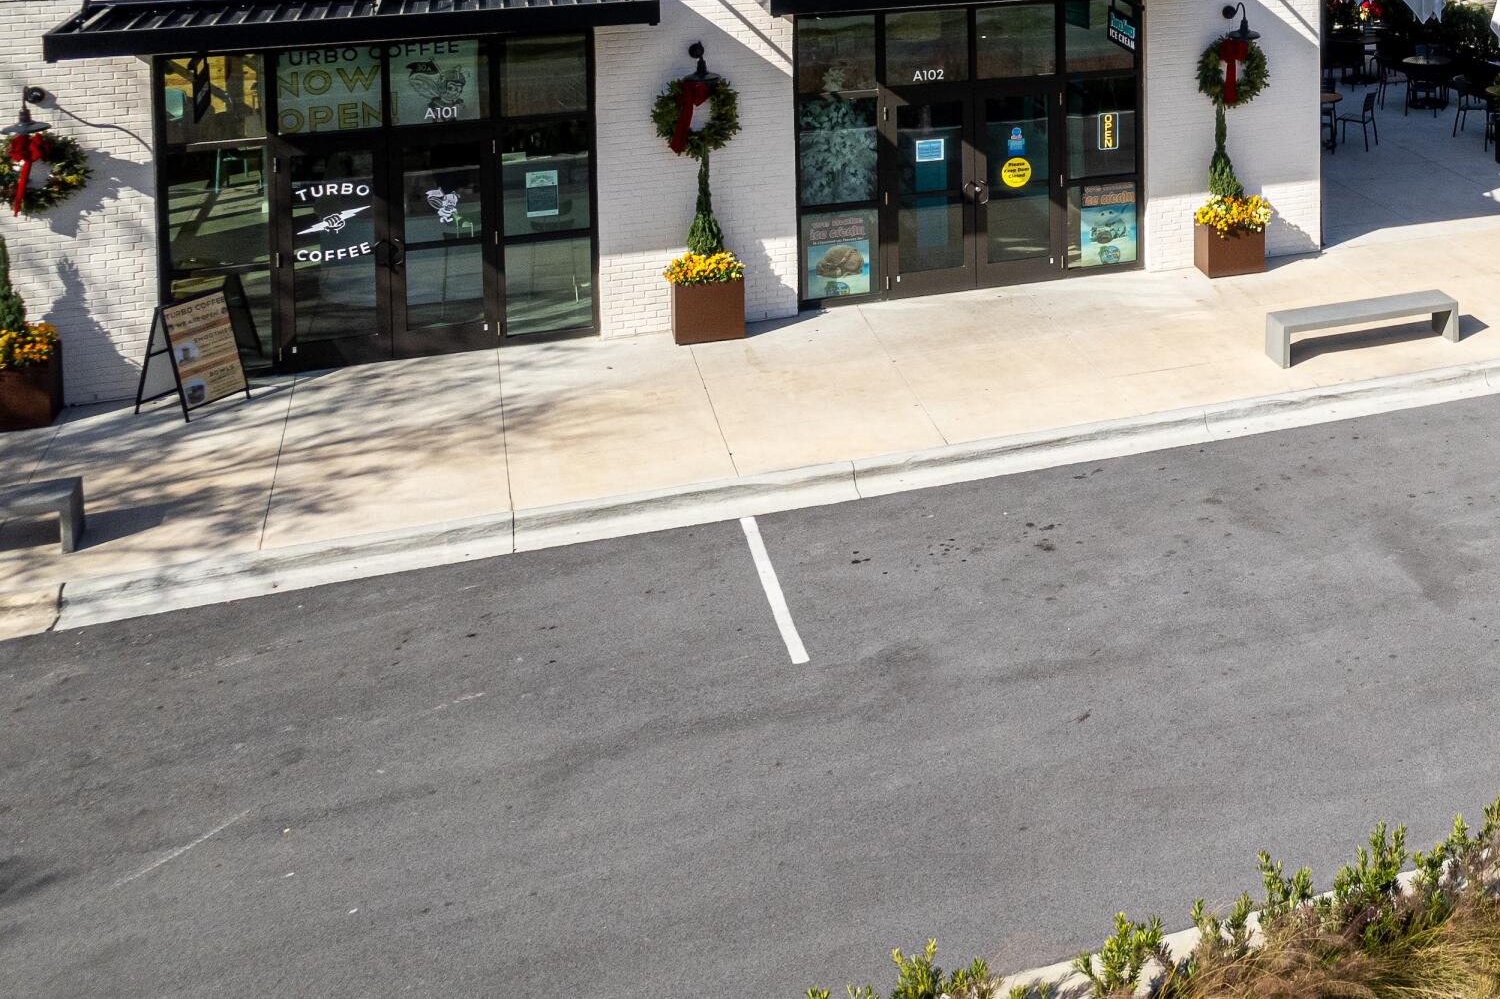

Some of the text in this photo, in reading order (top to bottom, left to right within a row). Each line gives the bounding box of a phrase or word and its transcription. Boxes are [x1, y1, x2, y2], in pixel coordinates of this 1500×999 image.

[1109, 27, 1136, 50] ICE CREAM
[276, 40, 460, 68] TURBO COFFEE
[276, 64, 381, 99] NOW
[913, 69, 944, 82] A102
[423, 106, 458, 120] A101
[1104, 114, 1113, 148] OPEN
[295, 183, 370, 201] TURBO
[297, 242, 371, 261] COFFEE
[165, 296, 226, 320] TURBO COFFEE
